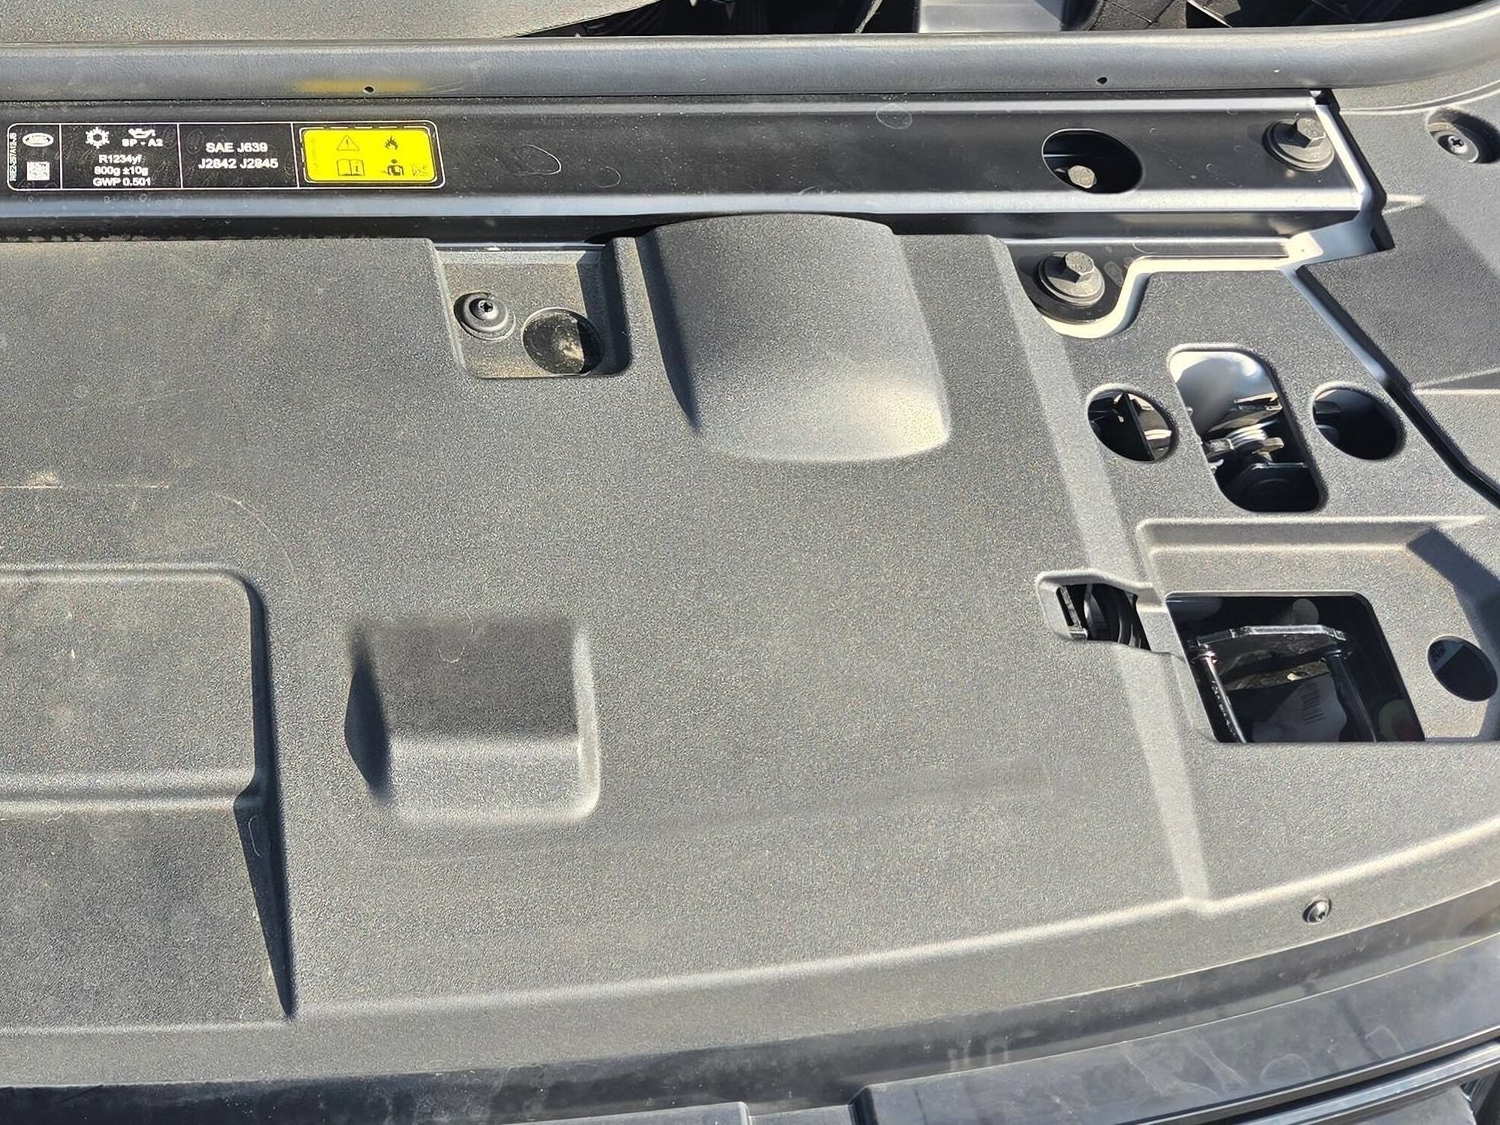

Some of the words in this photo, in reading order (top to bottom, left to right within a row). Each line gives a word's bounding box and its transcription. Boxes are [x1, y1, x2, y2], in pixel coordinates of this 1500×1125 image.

[148, 138, 164, 147] A2
[205, 142, 233, 153] SAE
[236, 142, 268, 153] J639
[98, 154, 142, 165] R1234yf
[198, 158, 237, 169] J2842
[239, 158, 279, 169] J2845
[122, 166, 149, 176] ±10g
[92, 177, 121, 186] GWP
[122, 177, 151, 186] 0.501
